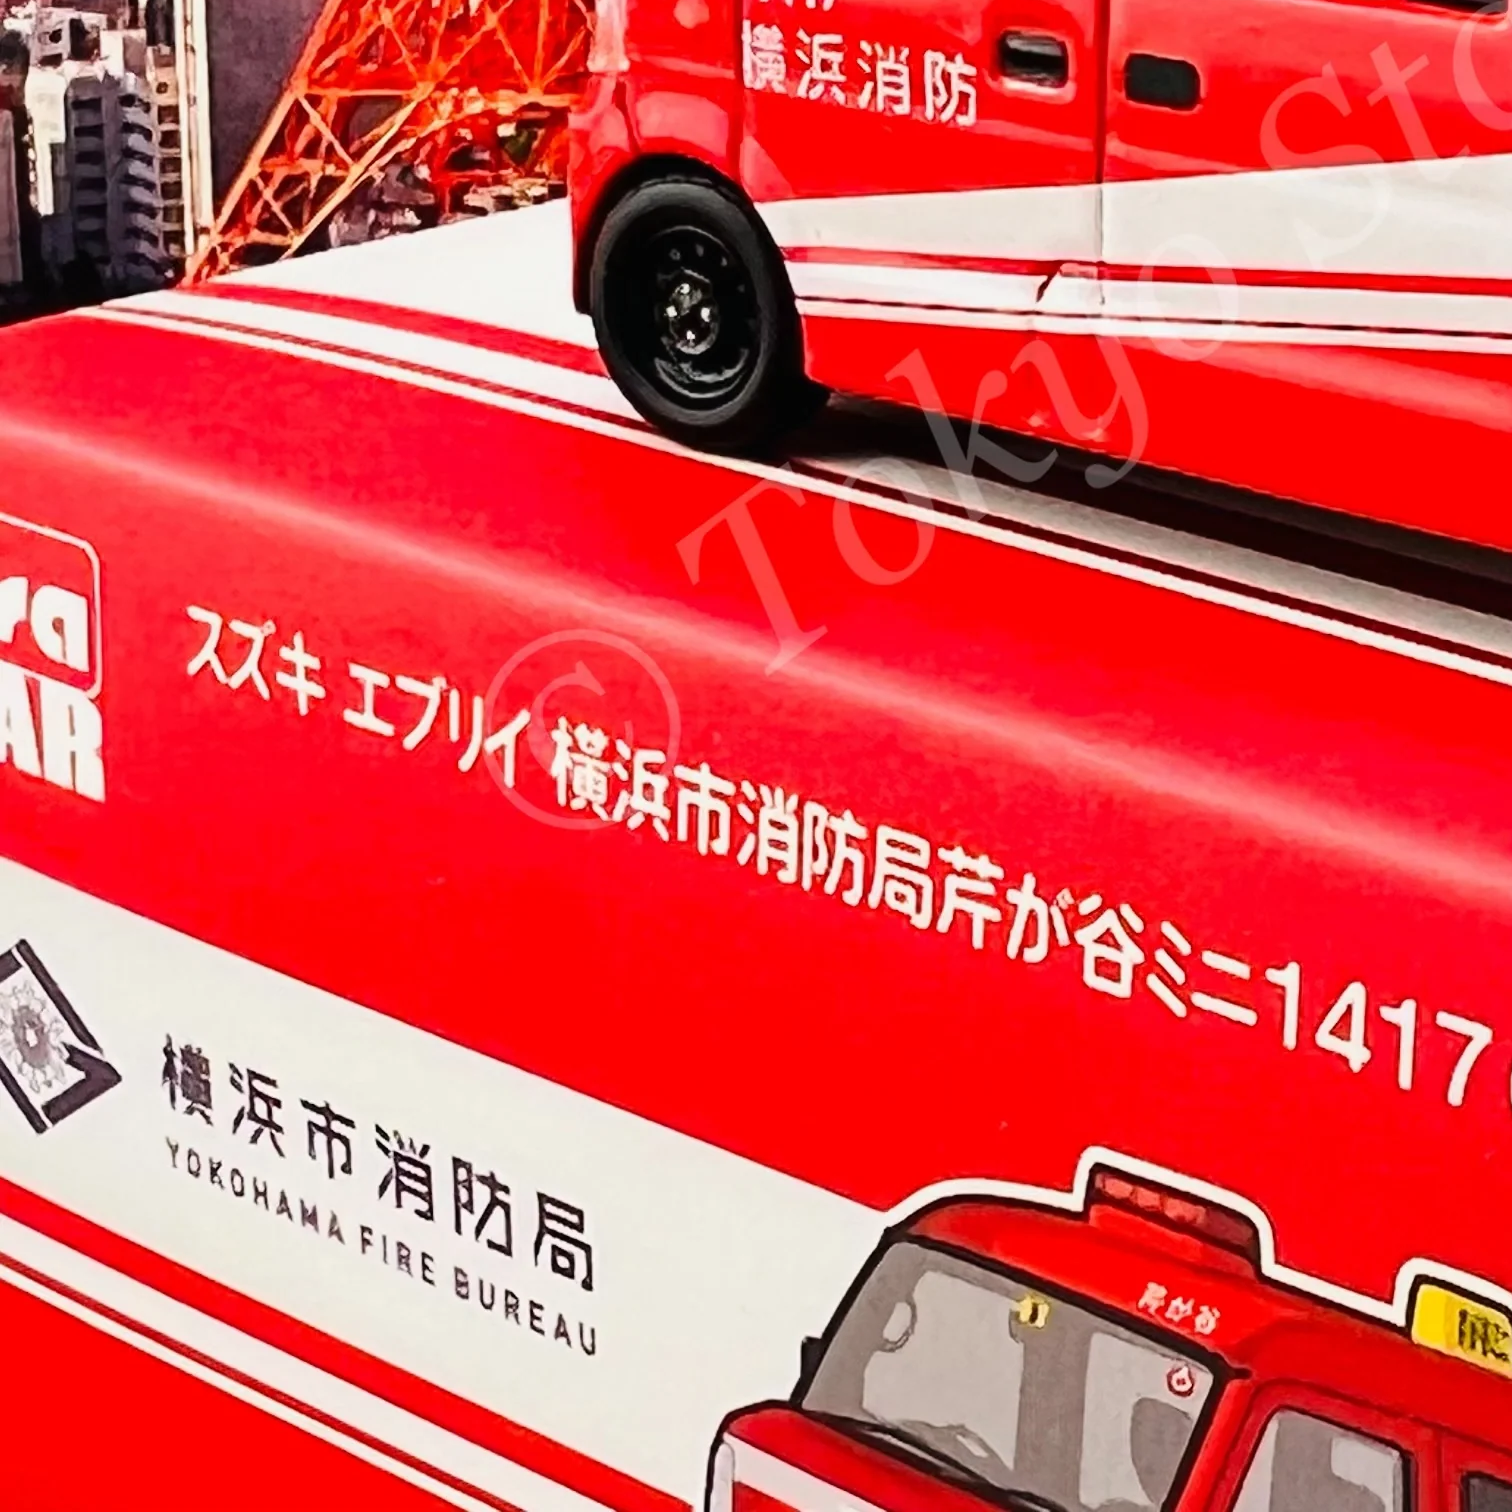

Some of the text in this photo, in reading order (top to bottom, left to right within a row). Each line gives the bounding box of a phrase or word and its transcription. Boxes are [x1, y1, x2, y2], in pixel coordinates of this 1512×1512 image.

[741, 19, 977, 126] 横浜消防
[186, 604, 326, 716] スズキ
[343, 662, 531, 788] エブリイ
[161, 1034, 594, 1292] 横浜市消防局
[165, 1137, 596, 1356] YOKOHAMA FIRE BUREAU
